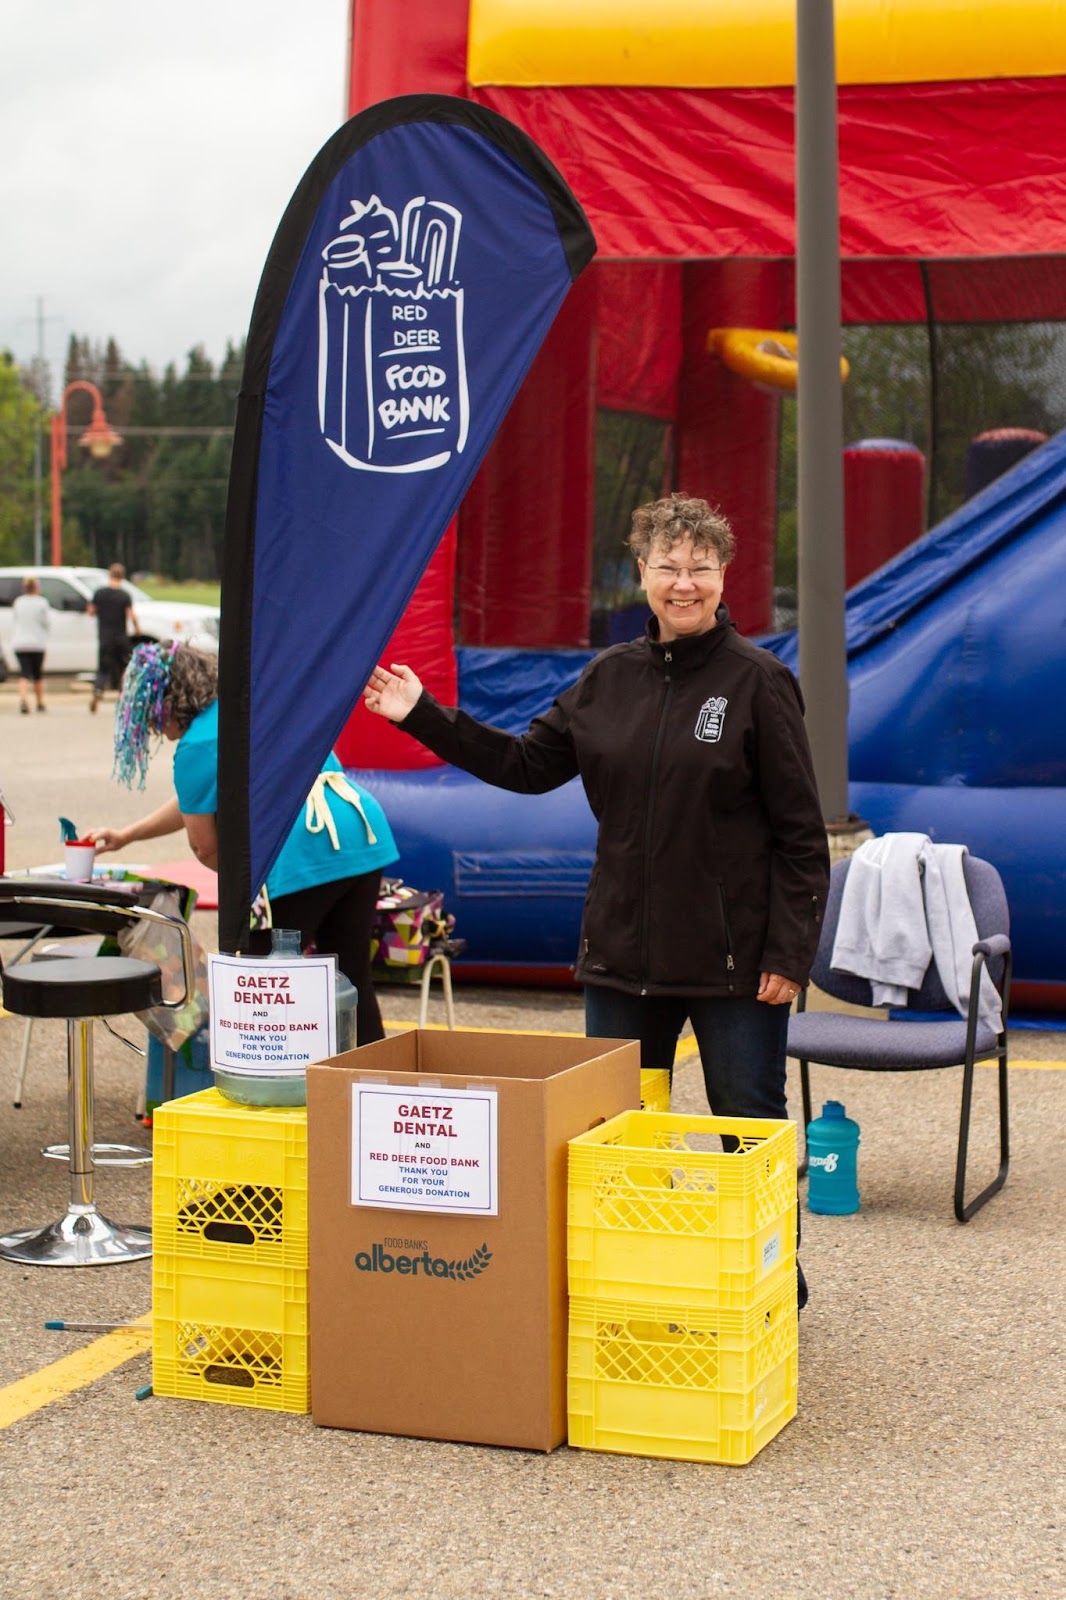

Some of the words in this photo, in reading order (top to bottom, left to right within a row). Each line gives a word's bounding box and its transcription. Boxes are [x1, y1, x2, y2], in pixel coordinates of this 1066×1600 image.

[392, 305, 428, 321] RED
[394, 330, 440, 346] DEER
[385, 364, 447, 391] FOOD
[378, 395, 451, 429] BANK
[237, 976, 290, 988] GAETZ
[234, 992, 295, 1004] DENTAL
[220, 1019, 231, 1028] RED
[234, 1022, 255, 1031] DEER
[290, 1023, 318, 1031] BANK
[226, 1051, 261, 1060] GENEROUS
[398, 1105, 453, 1119] GAETZ
[394, 1122, 457, 1137] DENTAL
[370, 1152, 388, 1161] RED
[392, 1154, 417, 1163] DEER
[420, 1156, 447, 1166] FOOD
[451, 1158, 479, 1167] BANK
[399, 1167, 428, 1175] THANK
[431, 1168, 448, 1176] YOU
[379, 1185, 423, 1195] GENEROUS
[426, 1189, 470, 1198] DONATION
[384, 1238, 403, 1248] FOOD
[404, 1239, 428, 1250] BANKS
[355, 1243, 449, 1277] alberta
